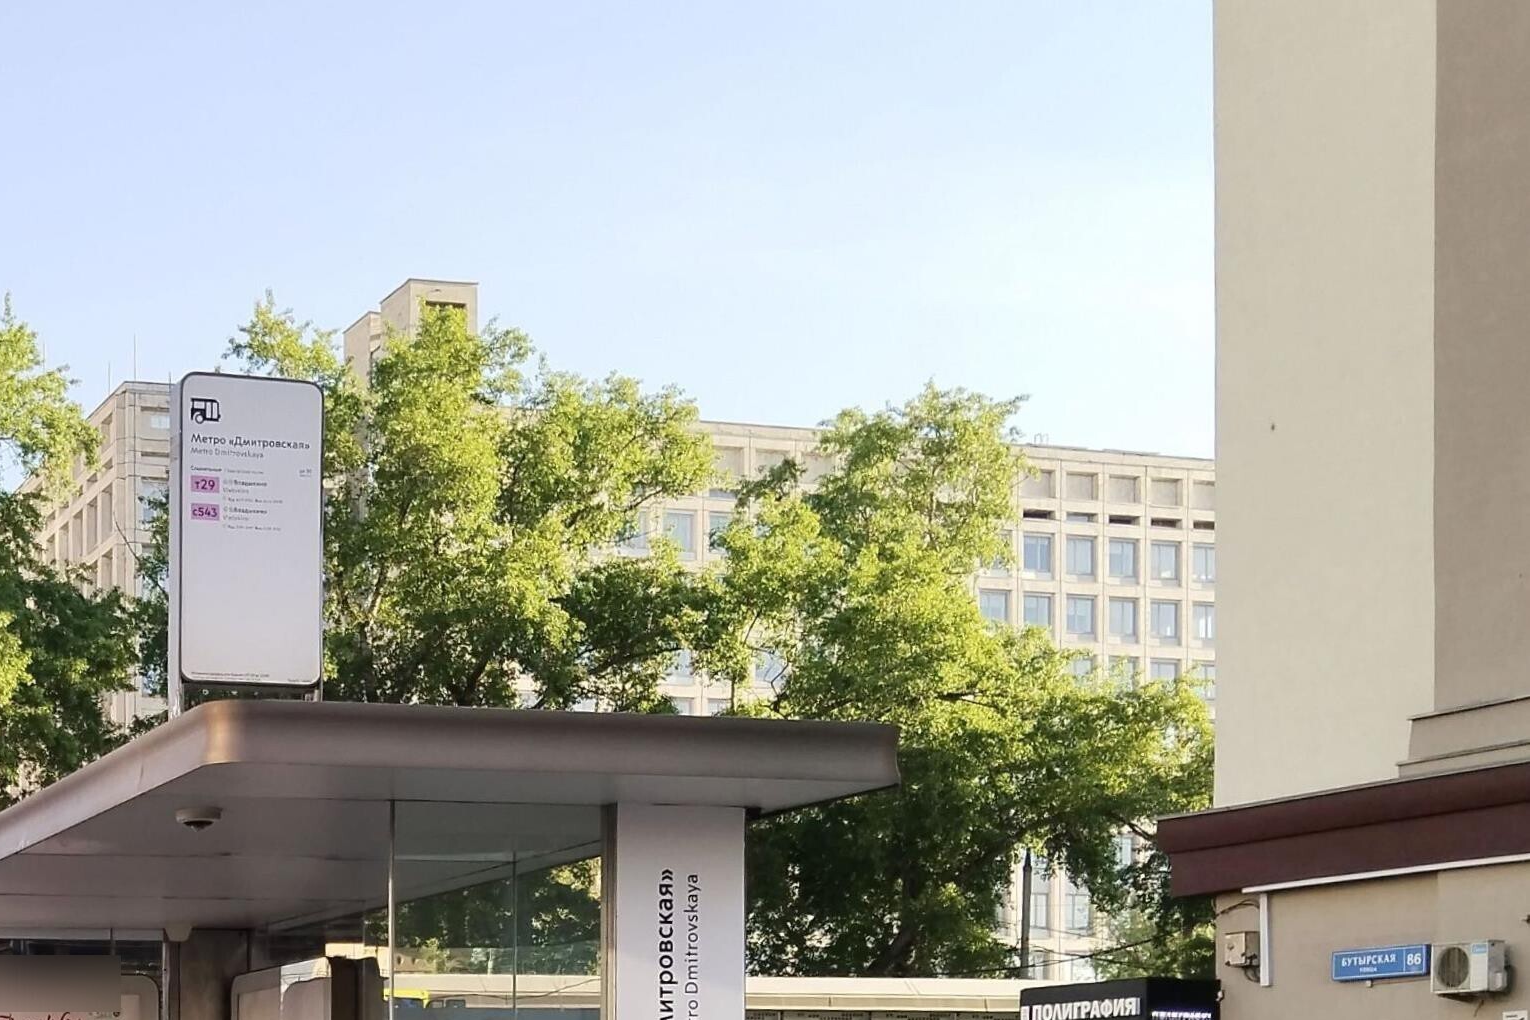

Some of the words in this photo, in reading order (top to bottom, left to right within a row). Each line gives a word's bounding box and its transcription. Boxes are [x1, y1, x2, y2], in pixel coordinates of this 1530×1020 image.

[191, 433, 226, 445] Метро
[229, 436, 310, 449] «Дмитровская»
[191, 447, 214, 455] Metro
[683, 874, 701, 996] Dmitrovskaya
[1342, 954, 1396, 967] БУТЫРСКАЯ
[1406, 953, 1421, 966] 86
